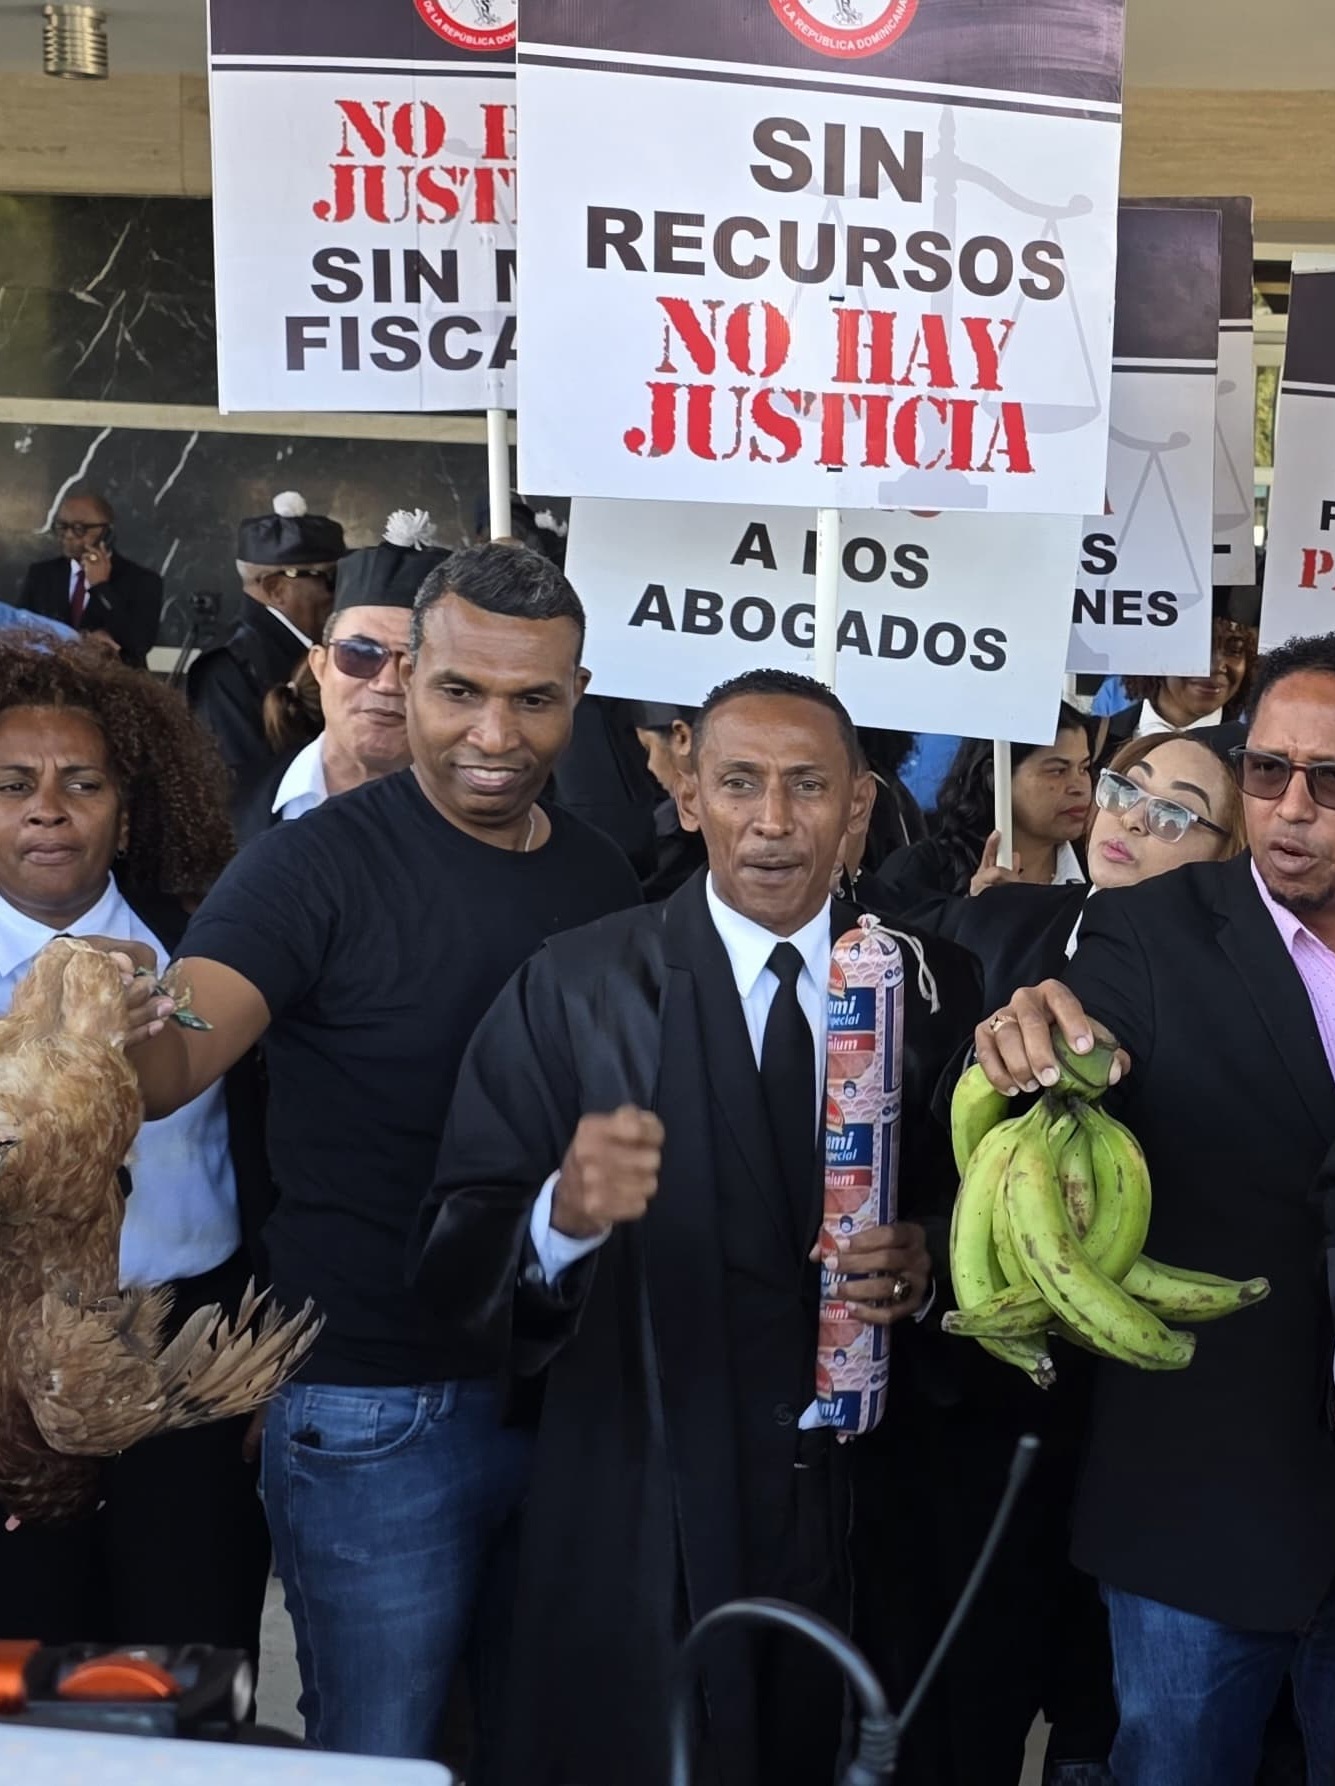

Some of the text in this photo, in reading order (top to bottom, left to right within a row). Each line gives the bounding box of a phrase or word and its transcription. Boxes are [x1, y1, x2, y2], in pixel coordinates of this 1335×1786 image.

[783, 3, 796, 22] LA
[334, 100, 446, 159] NO
[750, 116, 924, 203] SIN
[312, 164, 517, 225] JUST
[311, 248, 459, 304] SIN
[586, 205, 1065, 301] RECURSOS
[655, 296, 1015, 391] NO HAY
[623, 381, 1036, 474] JUSTICIA
[730, 522, 777, 571] A
[628, 584, 1009, 673] ABOGADOS
